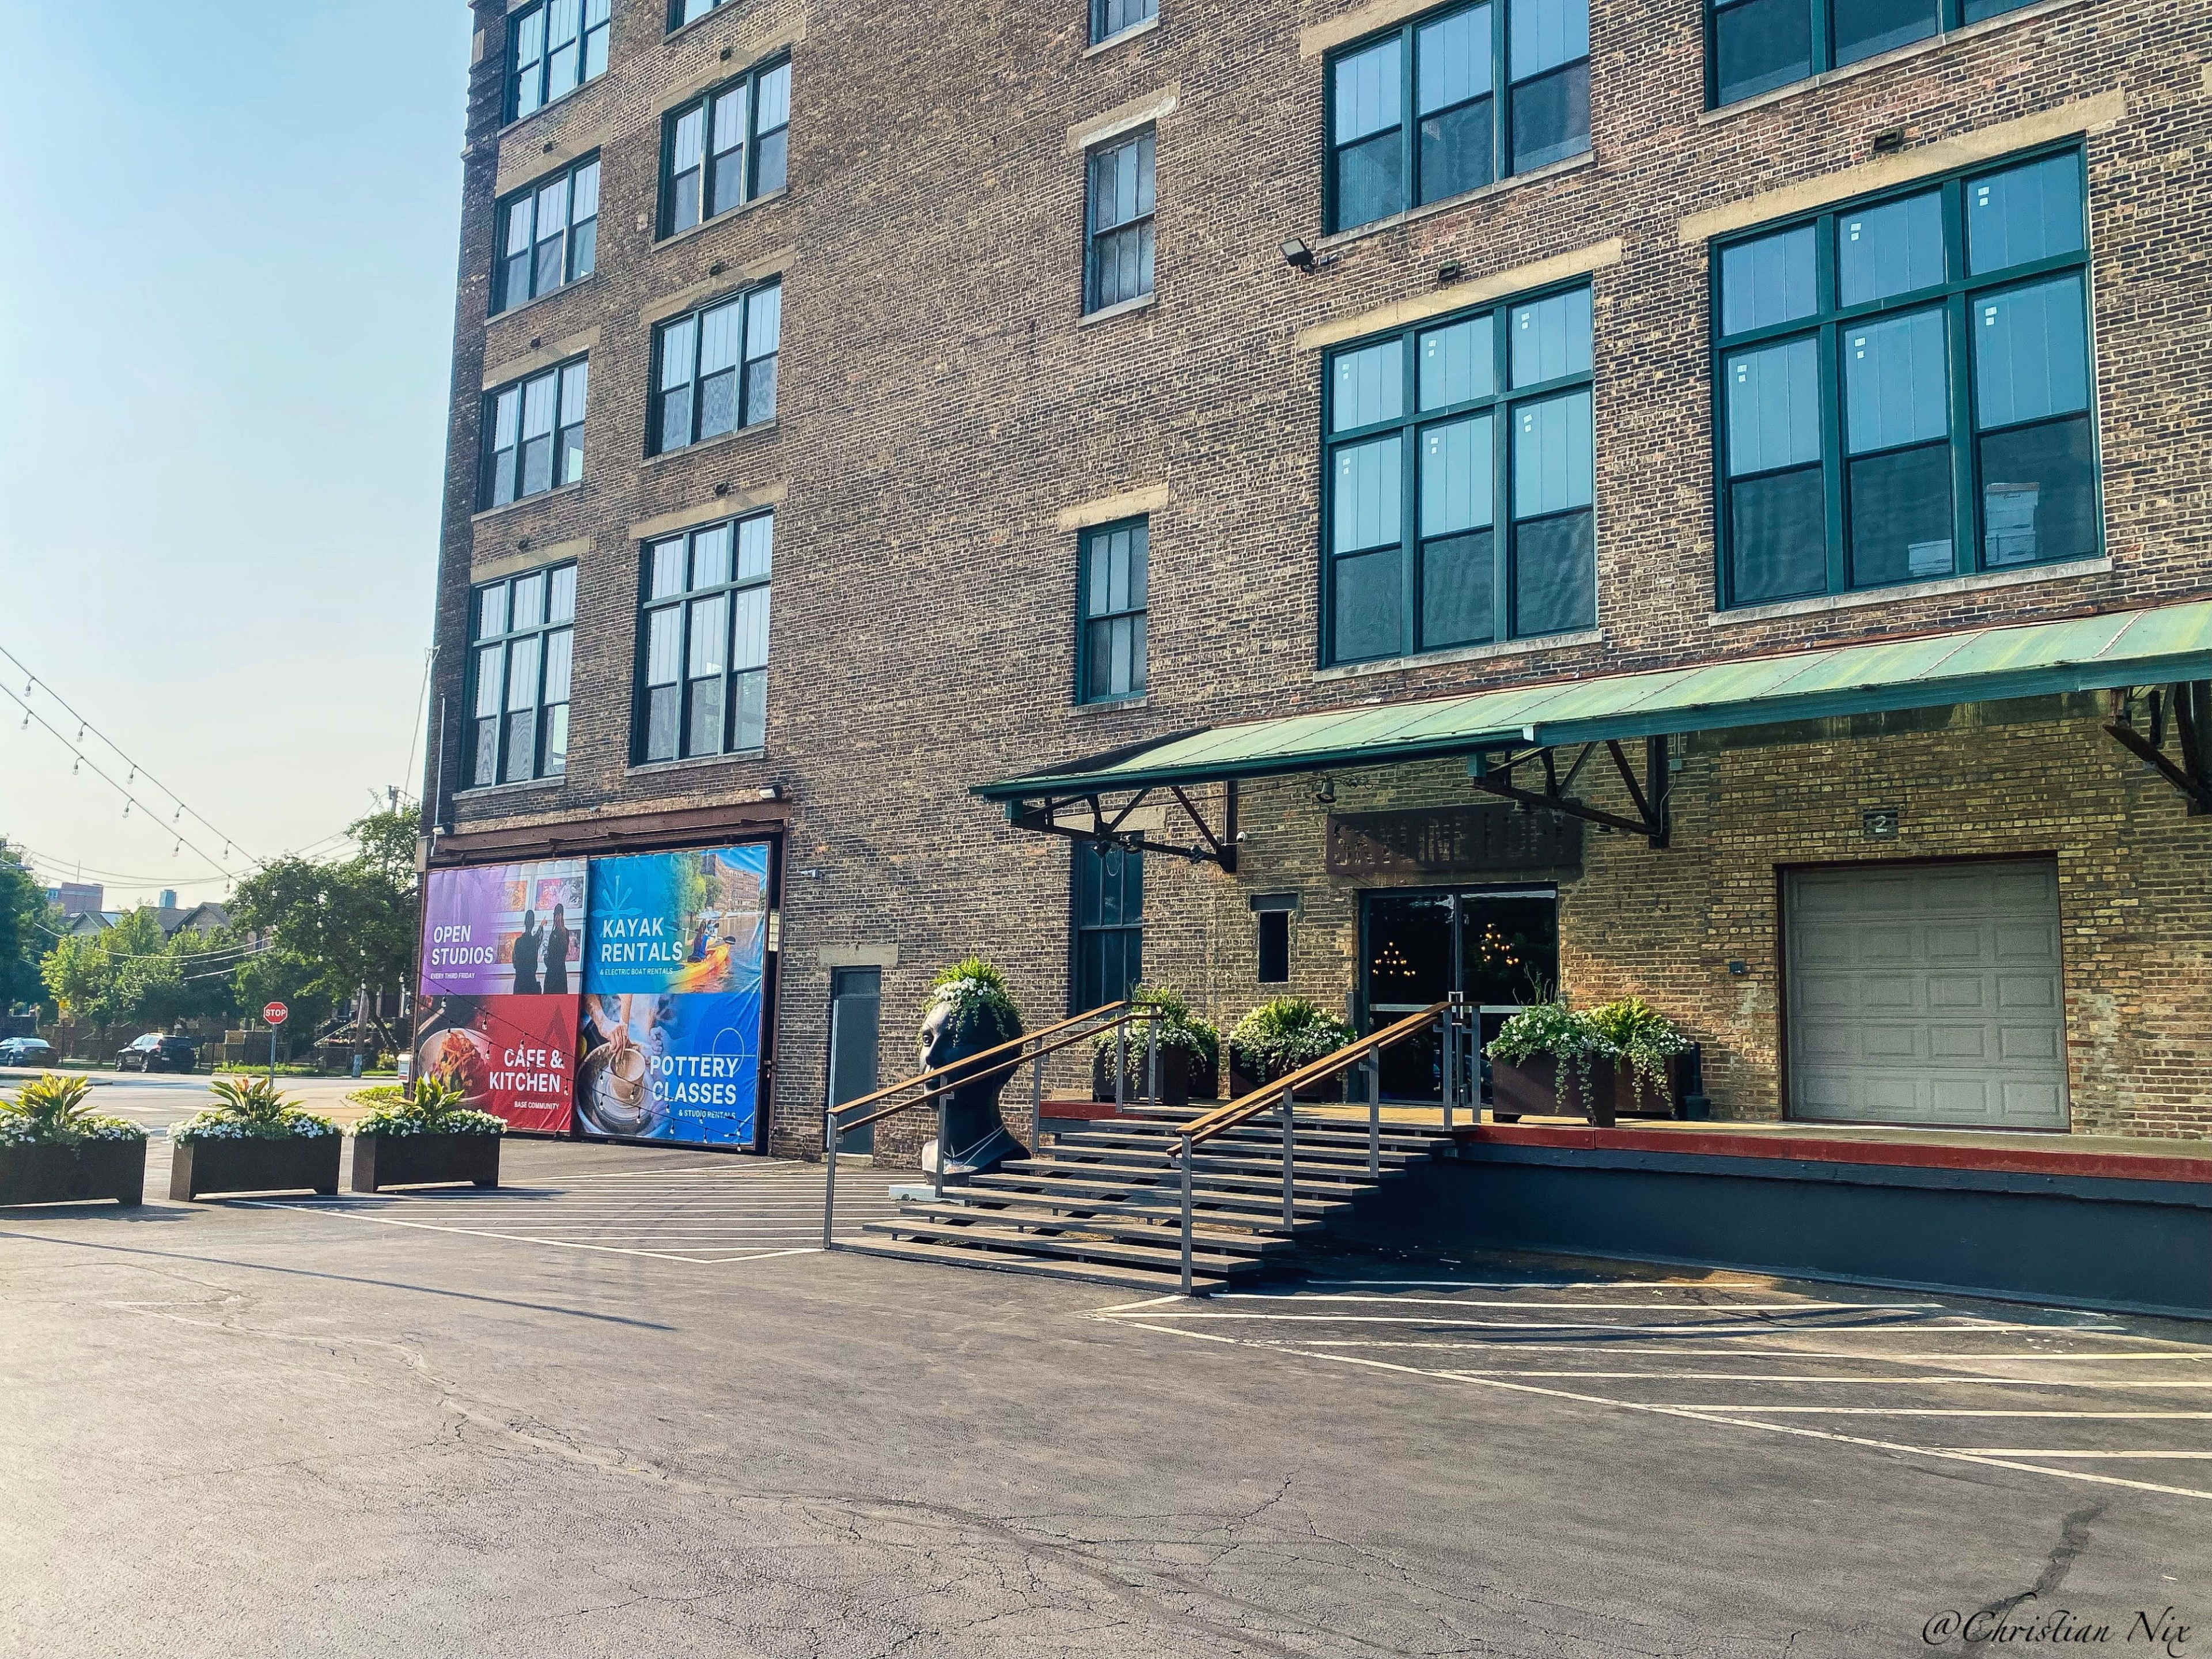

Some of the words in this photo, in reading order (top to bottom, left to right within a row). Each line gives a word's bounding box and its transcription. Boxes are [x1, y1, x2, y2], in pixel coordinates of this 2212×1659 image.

[1875, 816, 1888, 832] 2
[434, 925, 471, 944] OPEN
[603, 917, 664, 938] KAYAK
[431, 946, 493, 965] STUDIOS
[601, 941, 683, 962] RENTALS
[266, 1009, 286, 1017] STOP
[504, 1048, 546, 1067] CAFE
[550, 1049, 565, 1069] &
[650, 1055, 738, 1078] POTTERY
[490, 1071, 560, 1093] KITCHEN
[652, 1081, 736, 1105] CLASSES
[528, 1101, 559, 1110] COMMUNITY
